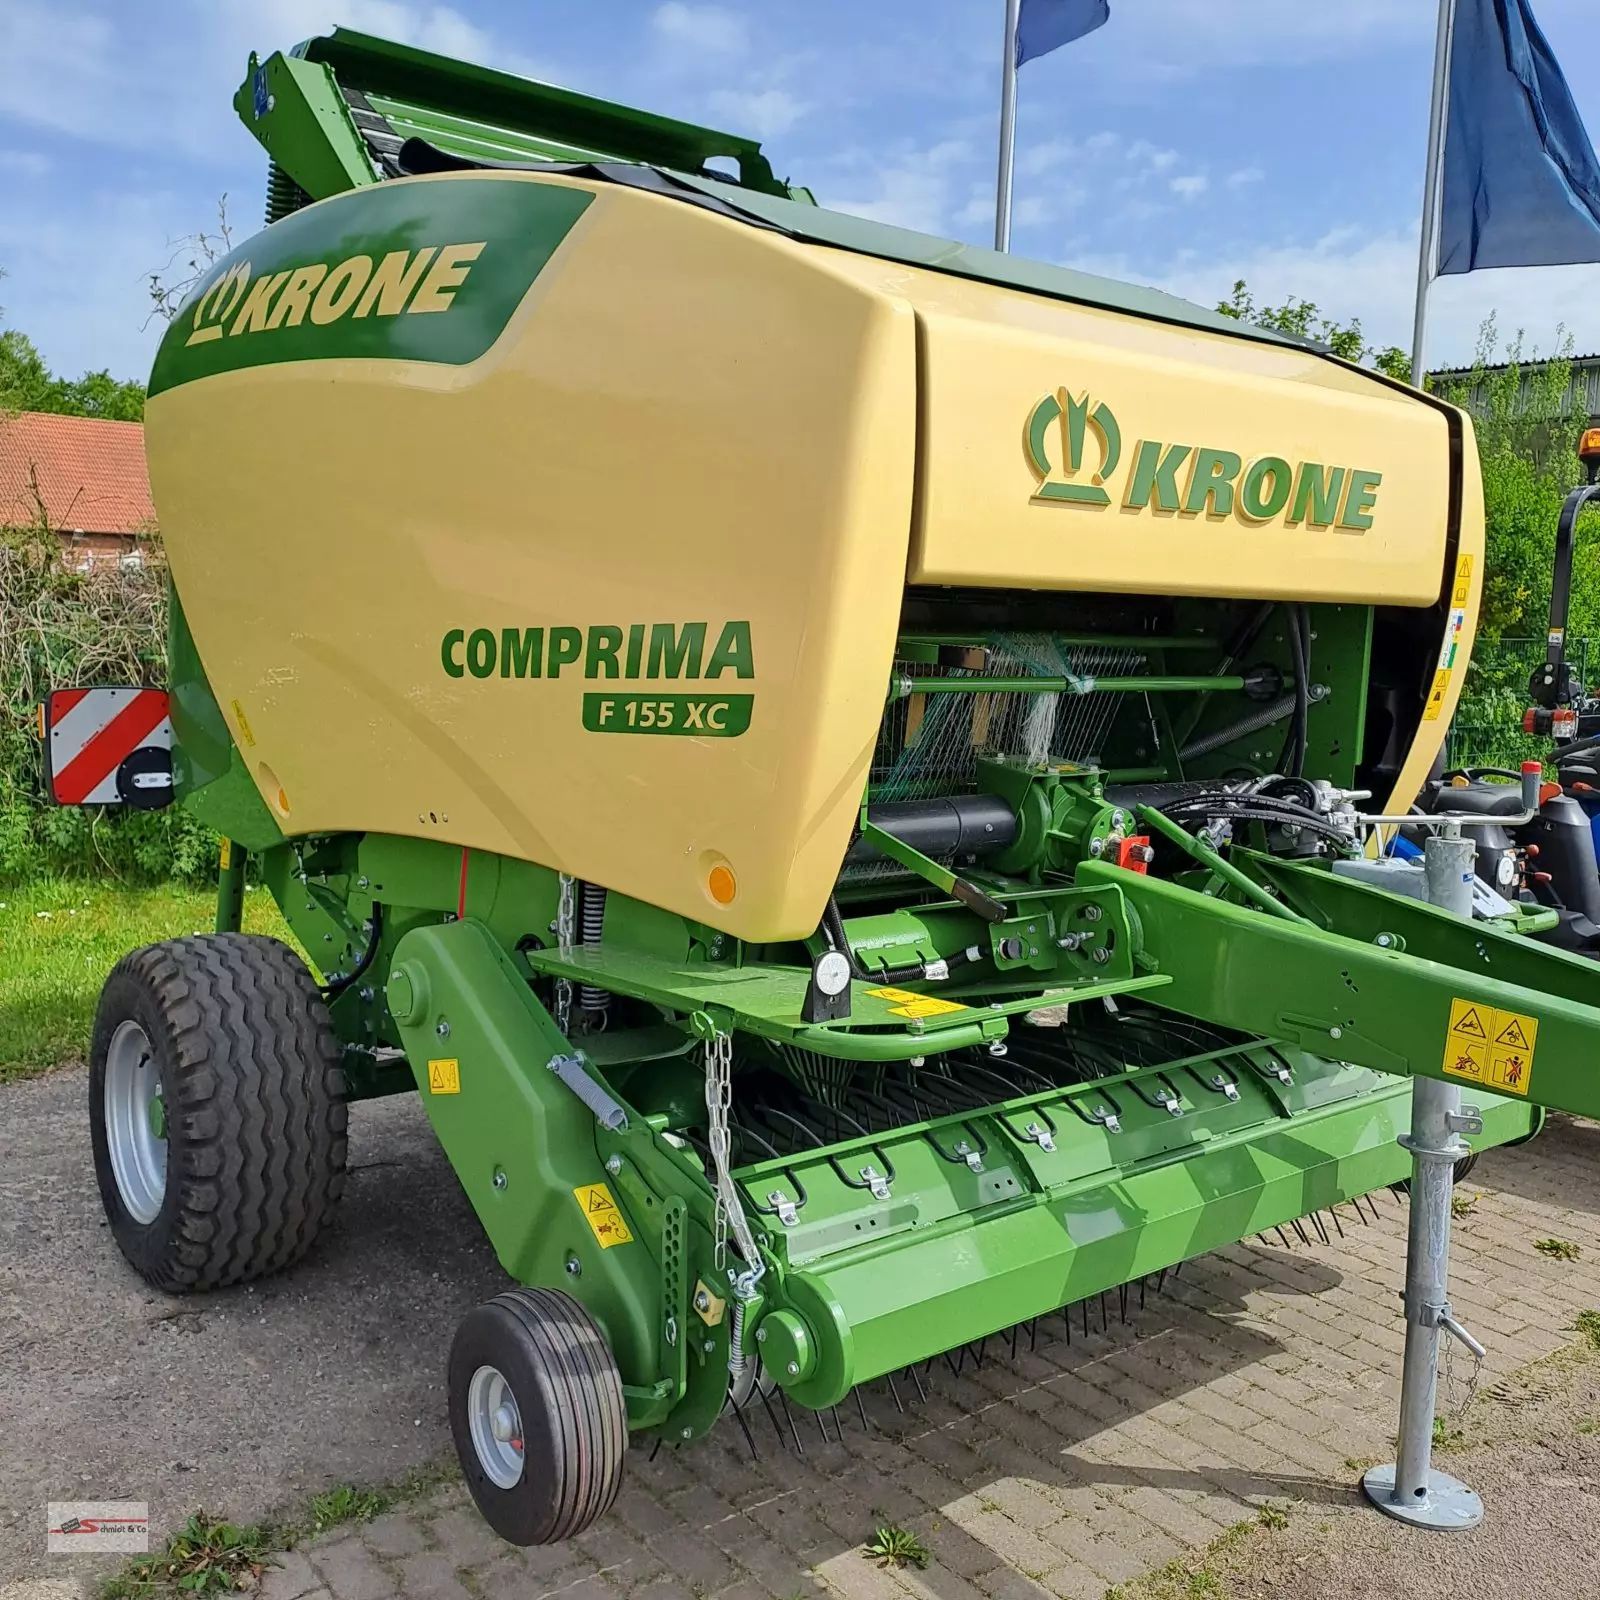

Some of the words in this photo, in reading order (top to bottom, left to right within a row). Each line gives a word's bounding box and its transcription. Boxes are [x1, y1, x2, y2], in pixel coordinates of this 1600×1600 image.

[229, 241, 487, 337] KRONE
[1120, 438, 1383, 535] KRONE
[441, 620, 755, 679] COMPRIMA
[599, 700, 615, 726] F
[623, 701, 674, 728] 155
[682, 702, 729, 729] XC
